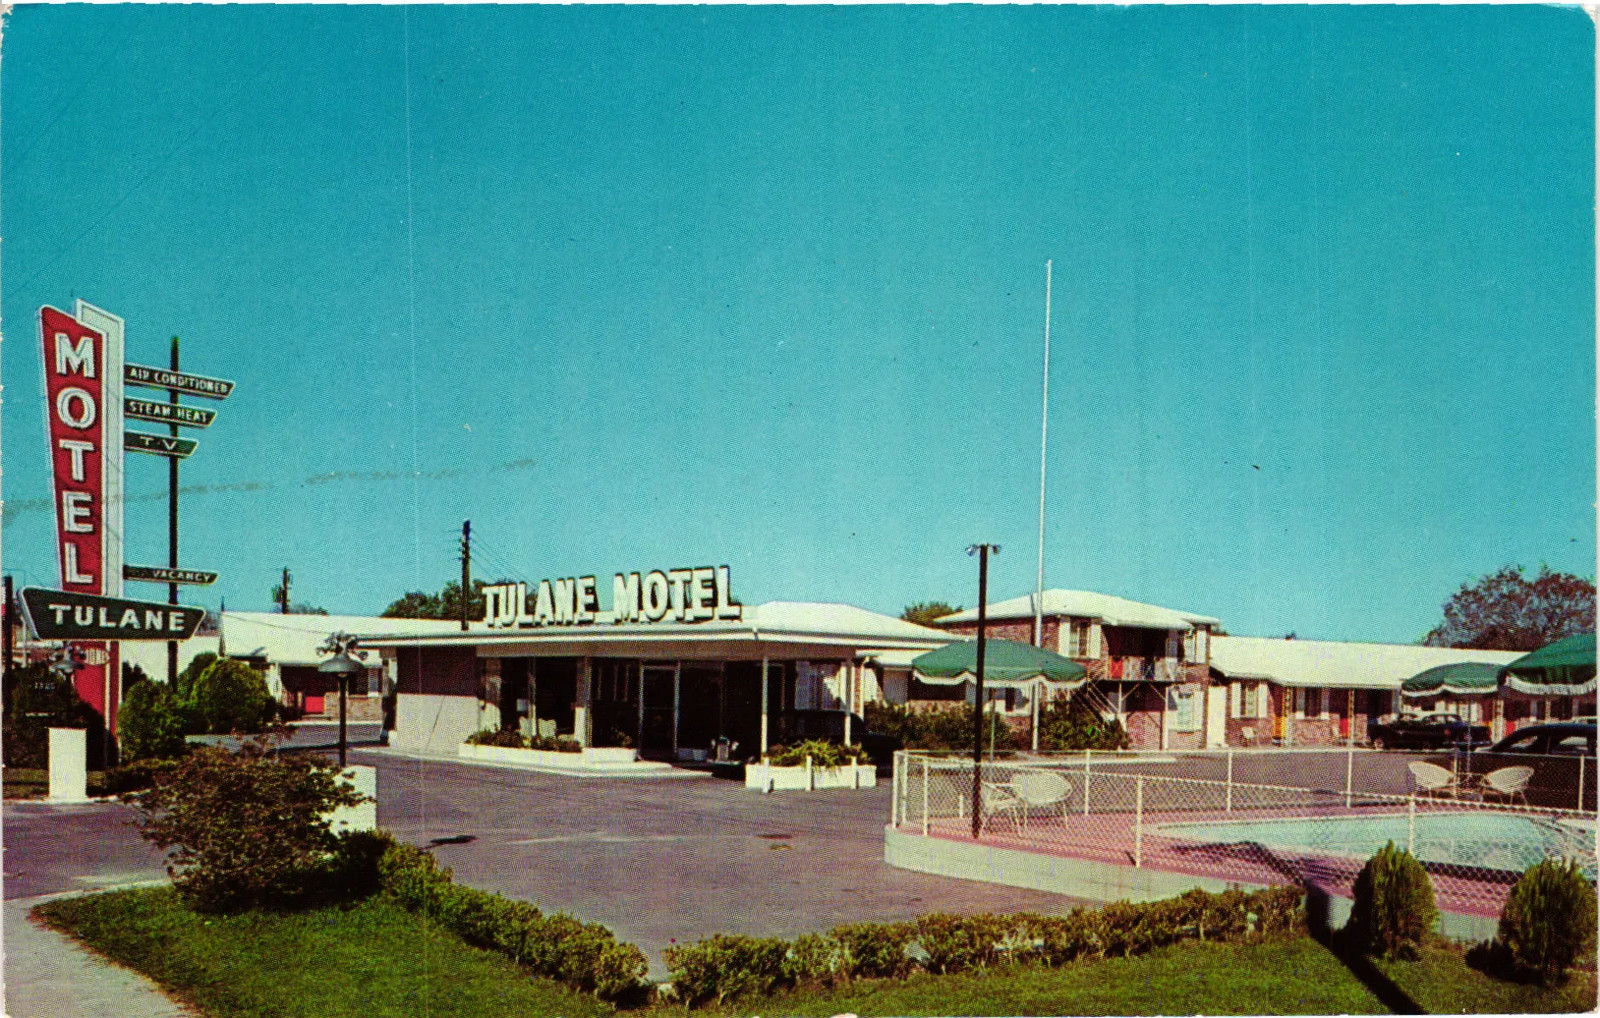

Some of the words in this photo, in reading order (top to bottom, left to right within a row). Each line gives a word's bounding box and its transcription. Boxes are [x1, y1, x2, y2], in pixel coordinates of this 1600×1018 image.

[130, 367, 149, 380] AIR
[154, 373, 228, 393] CONDITIONED
[129, 401, 170, 417] STEAM
[177, 409, 207, 423] HEAT
[54, 332, 96, 584] MOTEL
[152, 569, 212, 582] VACANCY
[482, 575, 598, 628] TULANE
[614, 565, 742, 624] MOTEL
[48, 602, 185, 631] TULANE
